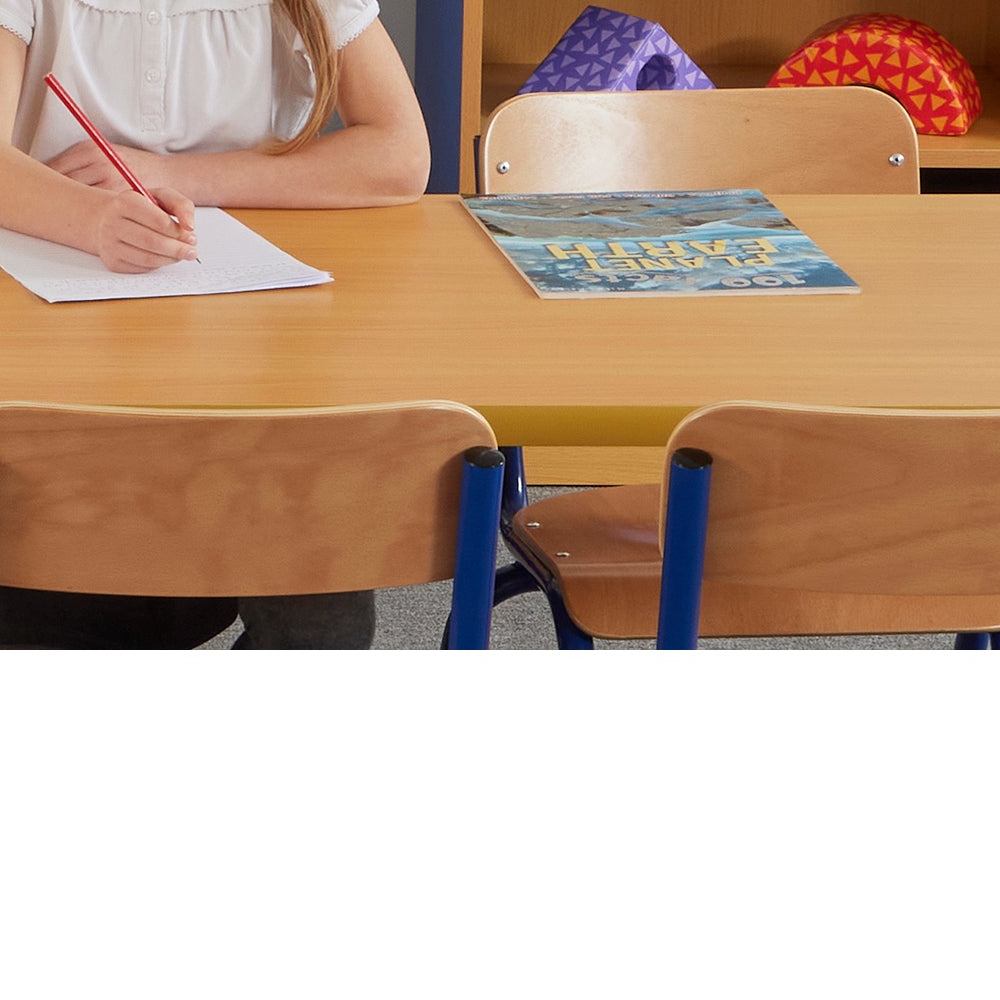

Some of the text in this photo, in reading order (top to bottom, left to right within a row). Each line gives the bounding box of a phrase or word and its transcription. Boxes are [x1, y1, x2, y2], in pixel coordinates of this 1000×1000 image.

[545, 238, 780, 260] EARTH
[583, 253, 776, 272] PLANET
[574, 272, 807, 288] 100 facts
